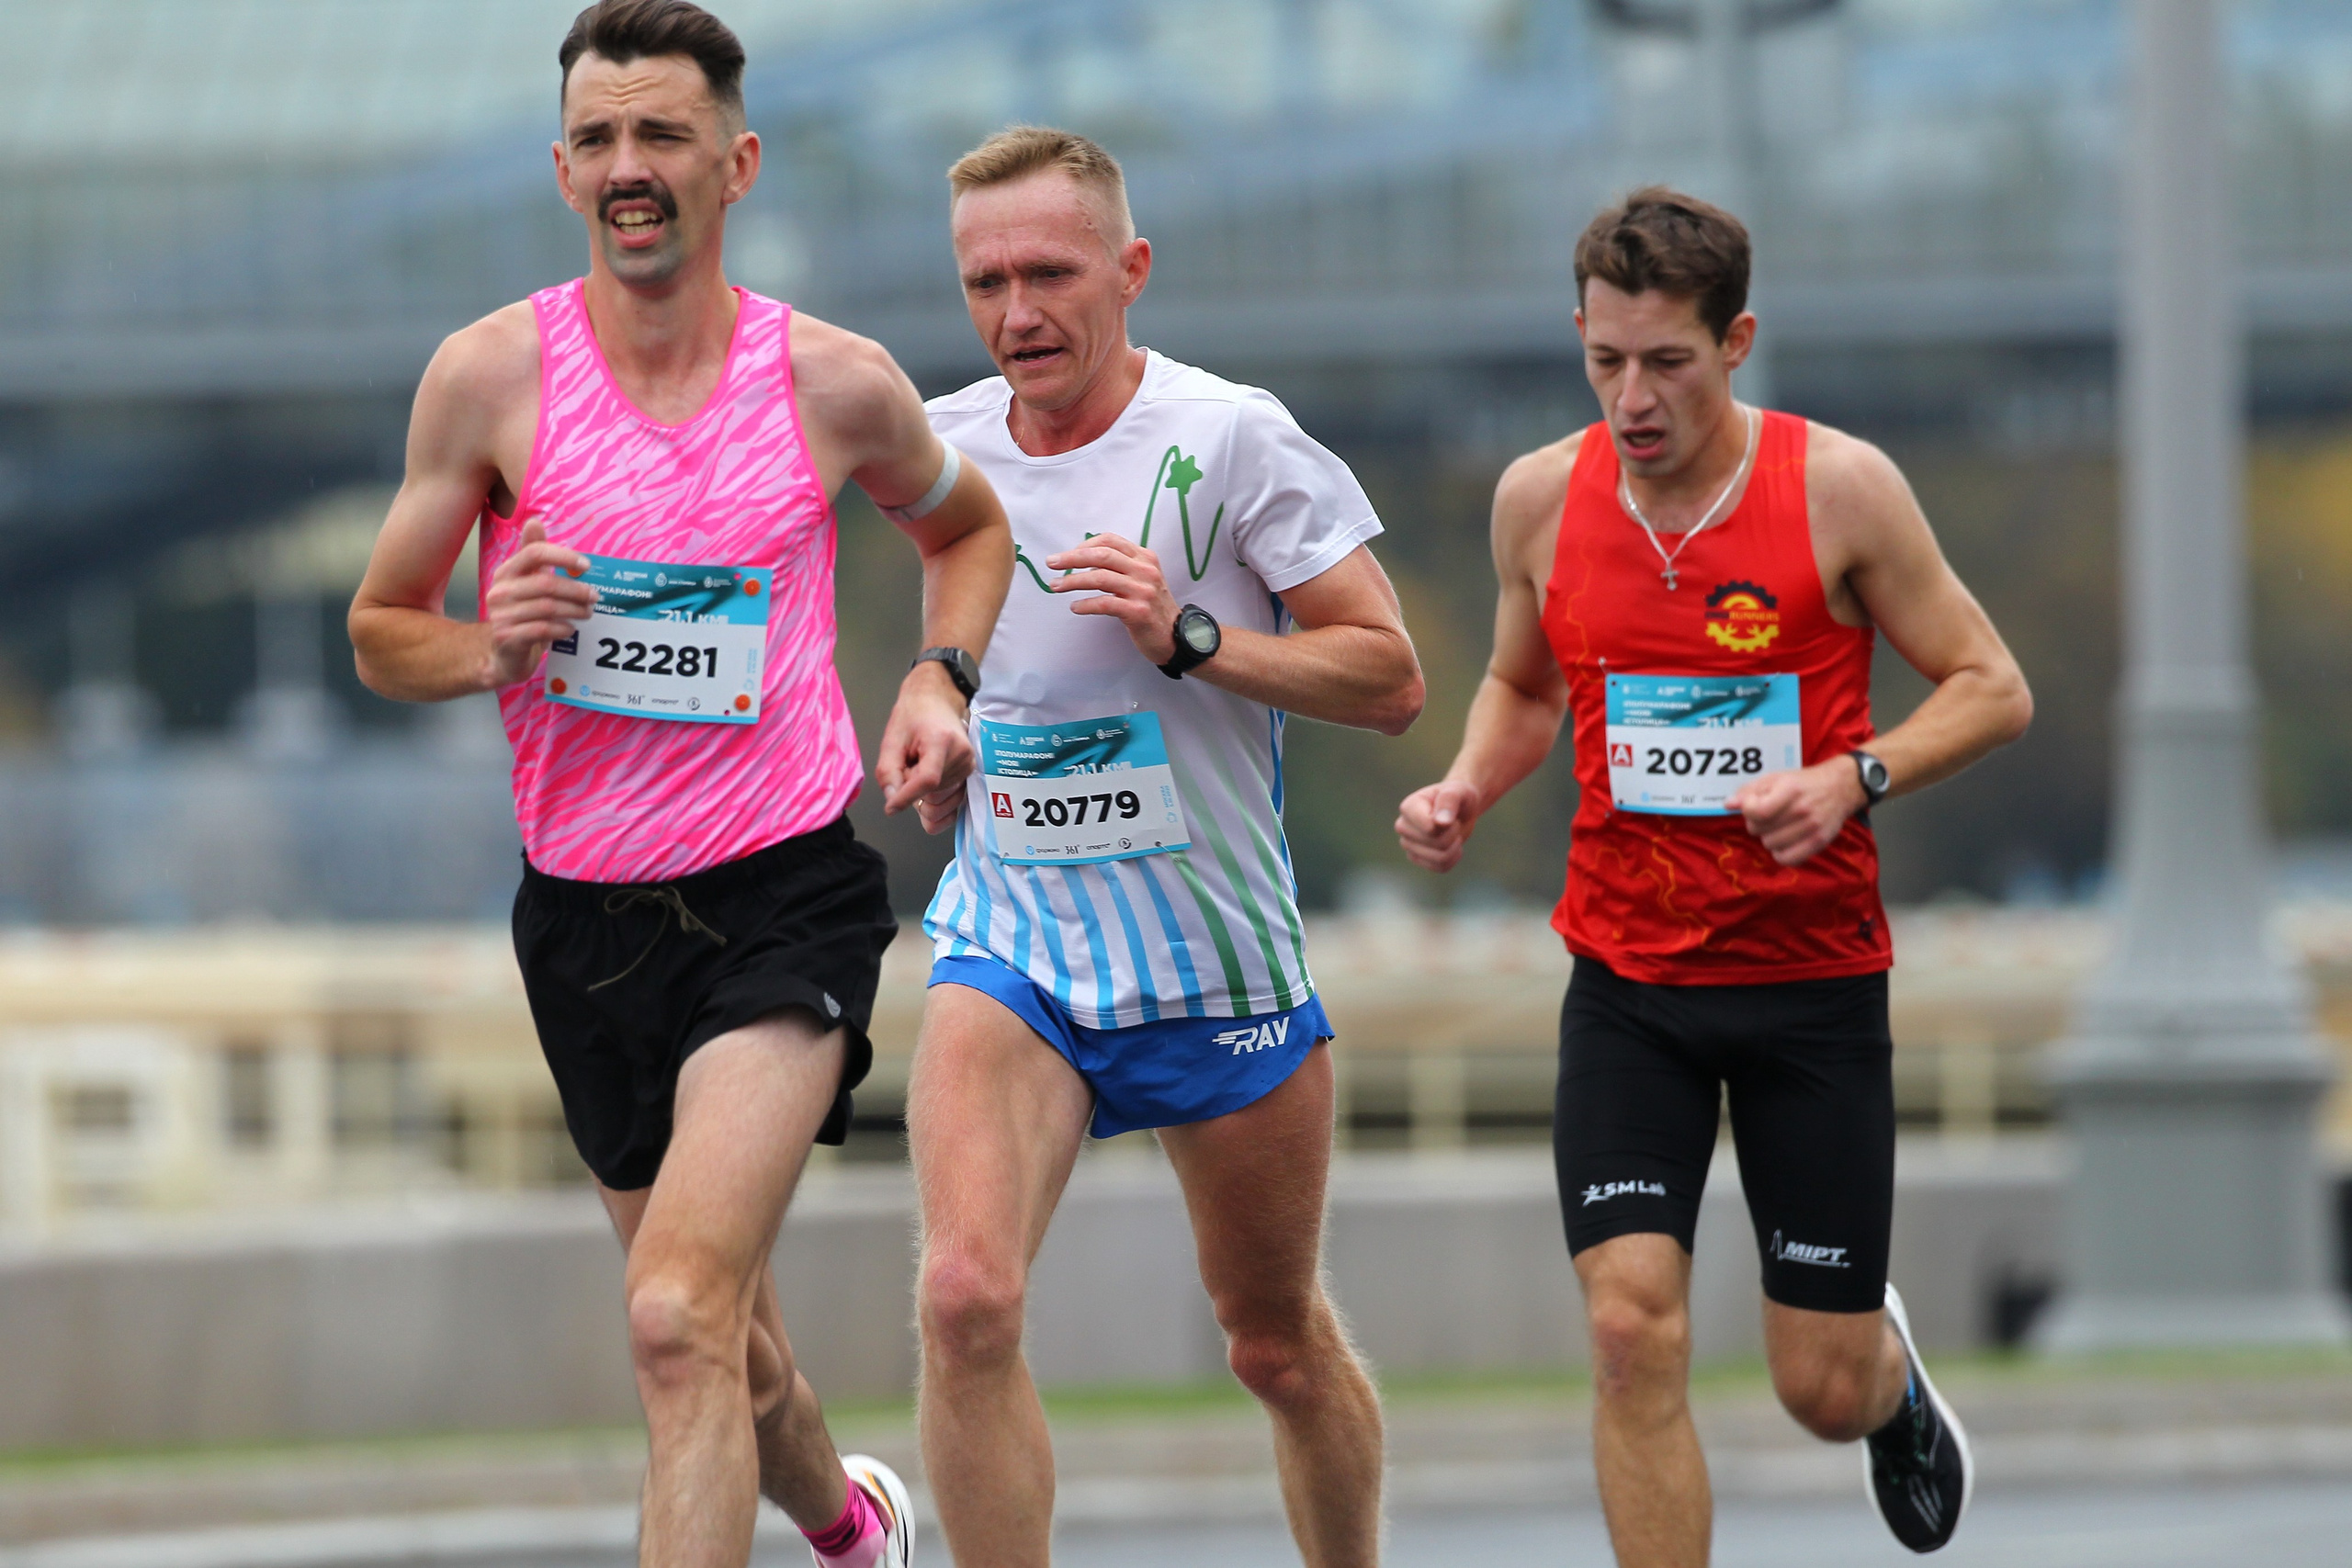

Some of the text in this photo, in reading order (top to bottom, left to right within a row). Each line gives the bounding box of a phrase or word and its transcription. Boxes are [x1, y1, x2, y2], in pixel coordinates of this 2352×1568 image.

[595, 637, 718, 678] 22281
[1645, 747, 1763, 775] 20728
[1021, 790, 1141, 828] 20779
[1784, 1240, 1848, 1263] MIPT
